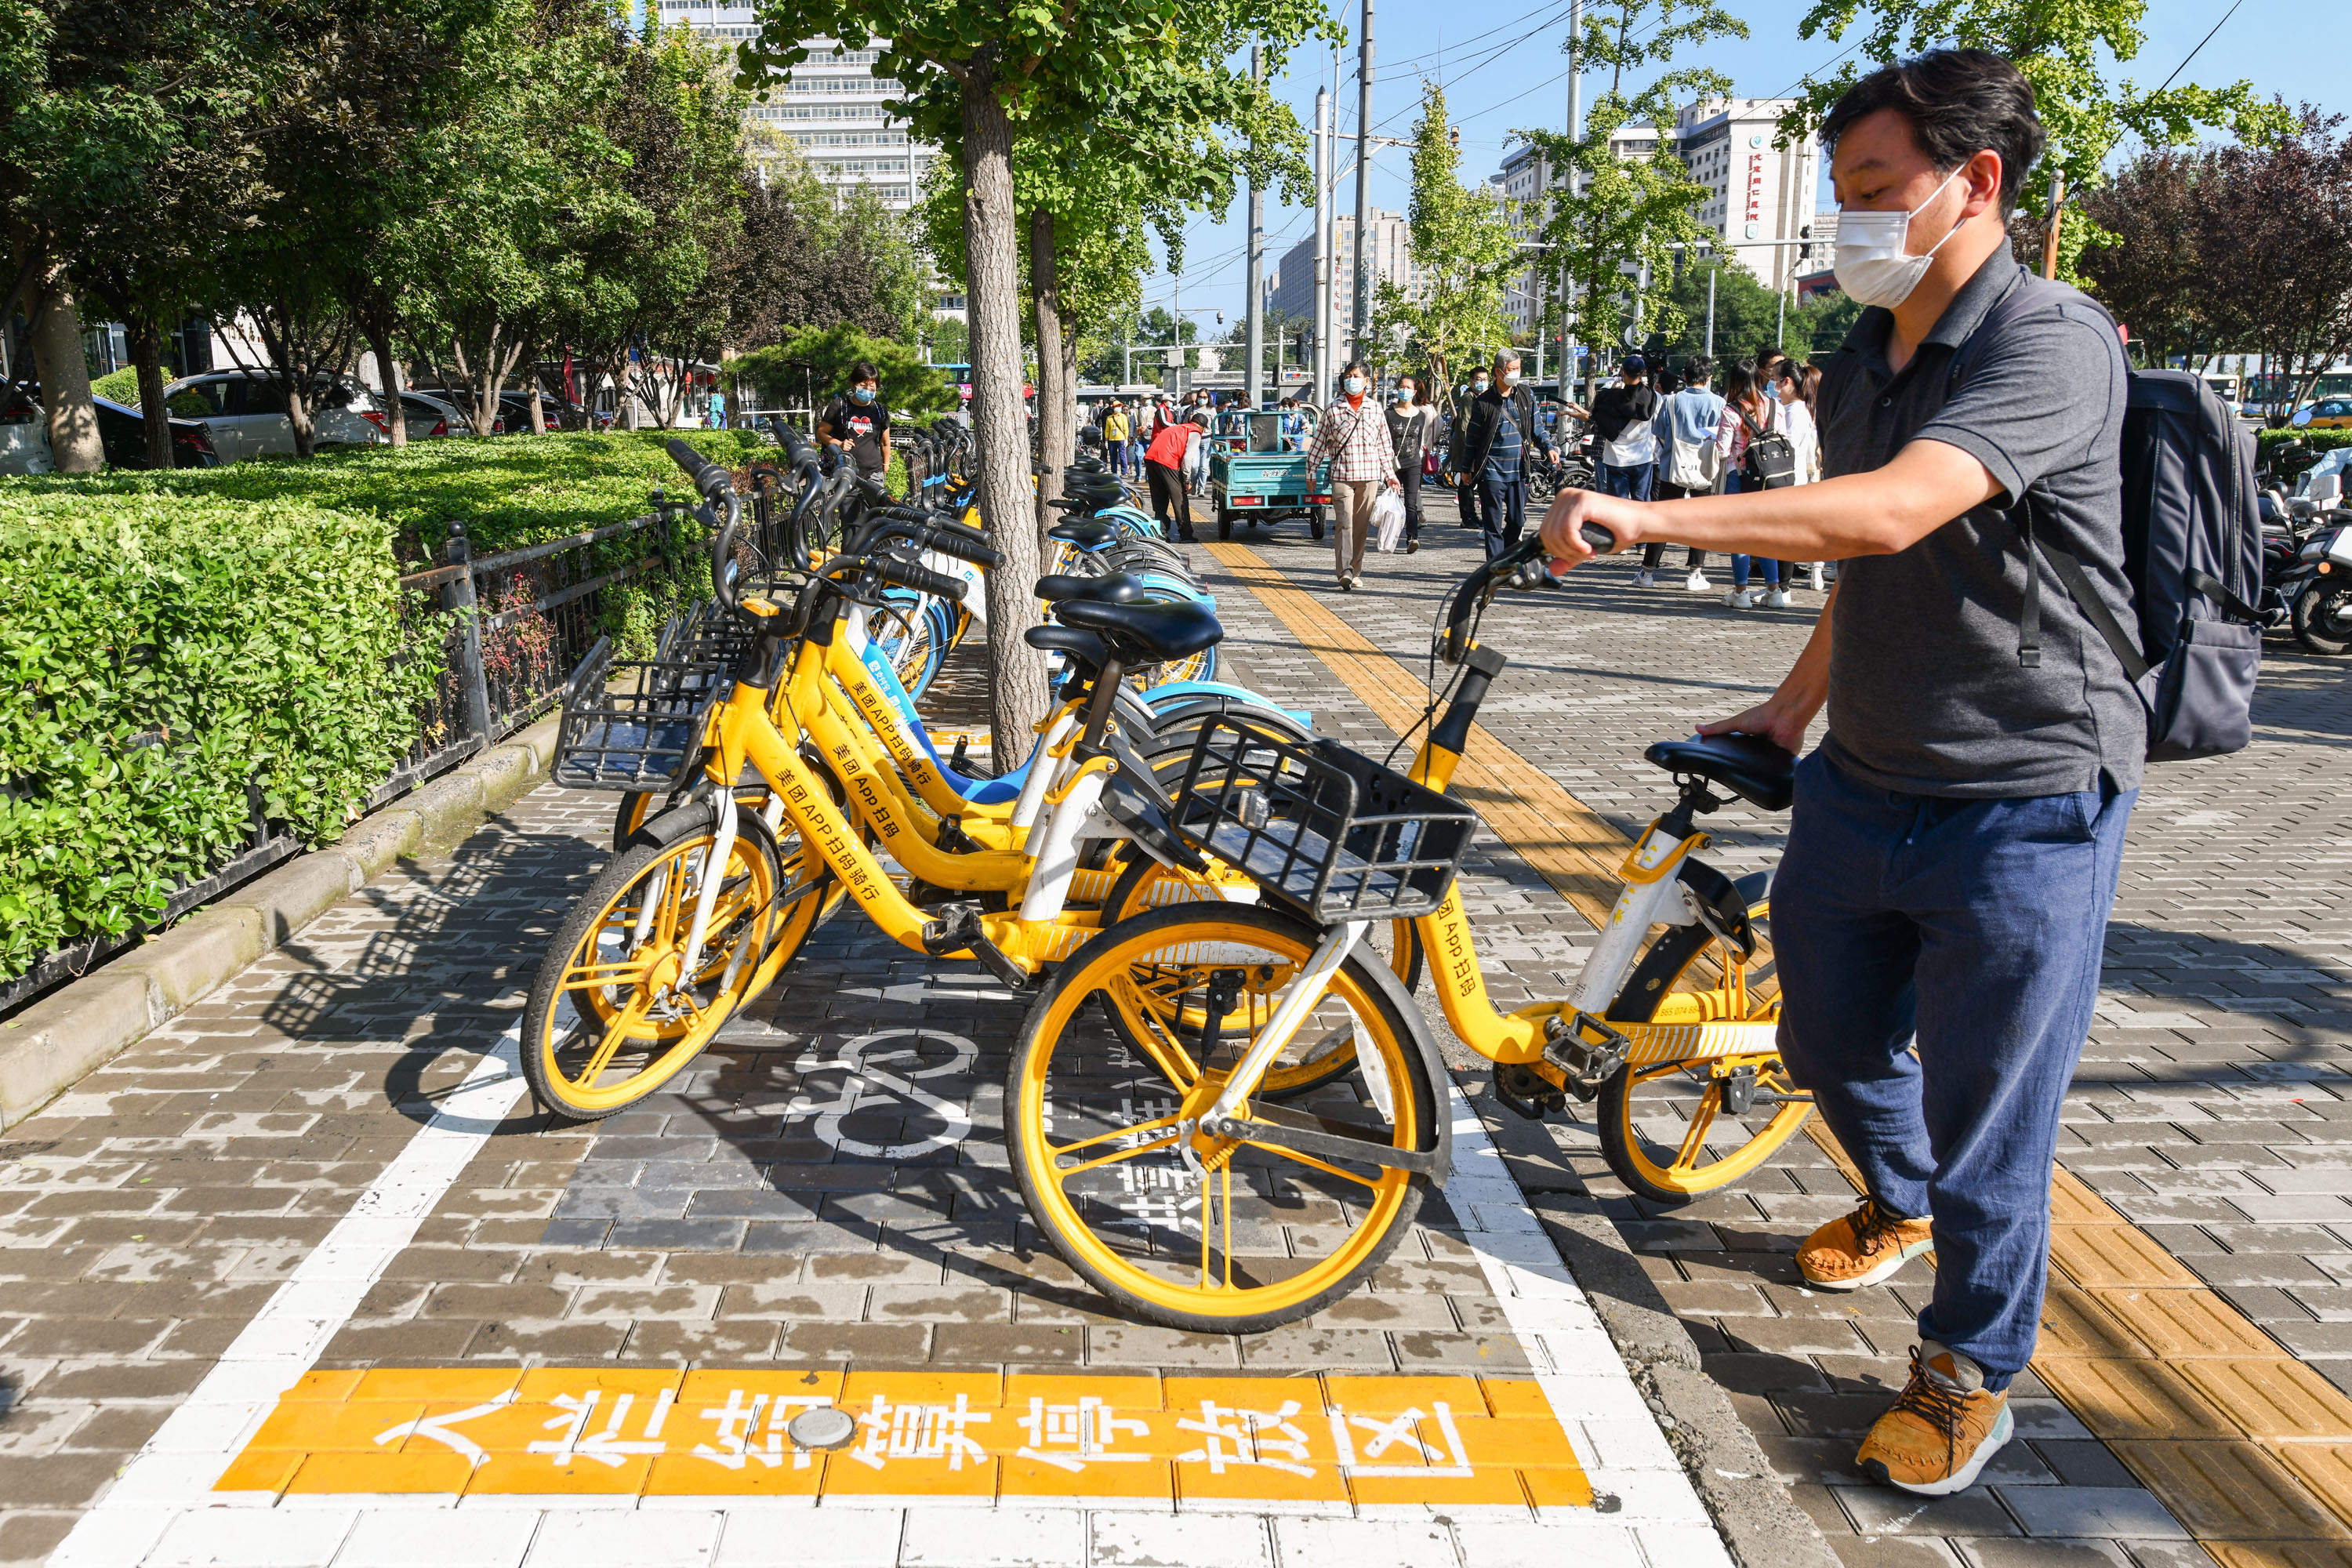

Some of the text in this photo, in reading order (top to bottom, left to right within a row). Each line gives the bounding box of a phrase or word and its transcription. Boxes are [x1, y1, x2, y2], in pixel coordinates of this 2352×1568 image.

[1436, 898, 1476, 997] 团App扫码
[373, 1388, 1475, 1479] 入栏结算停放区
